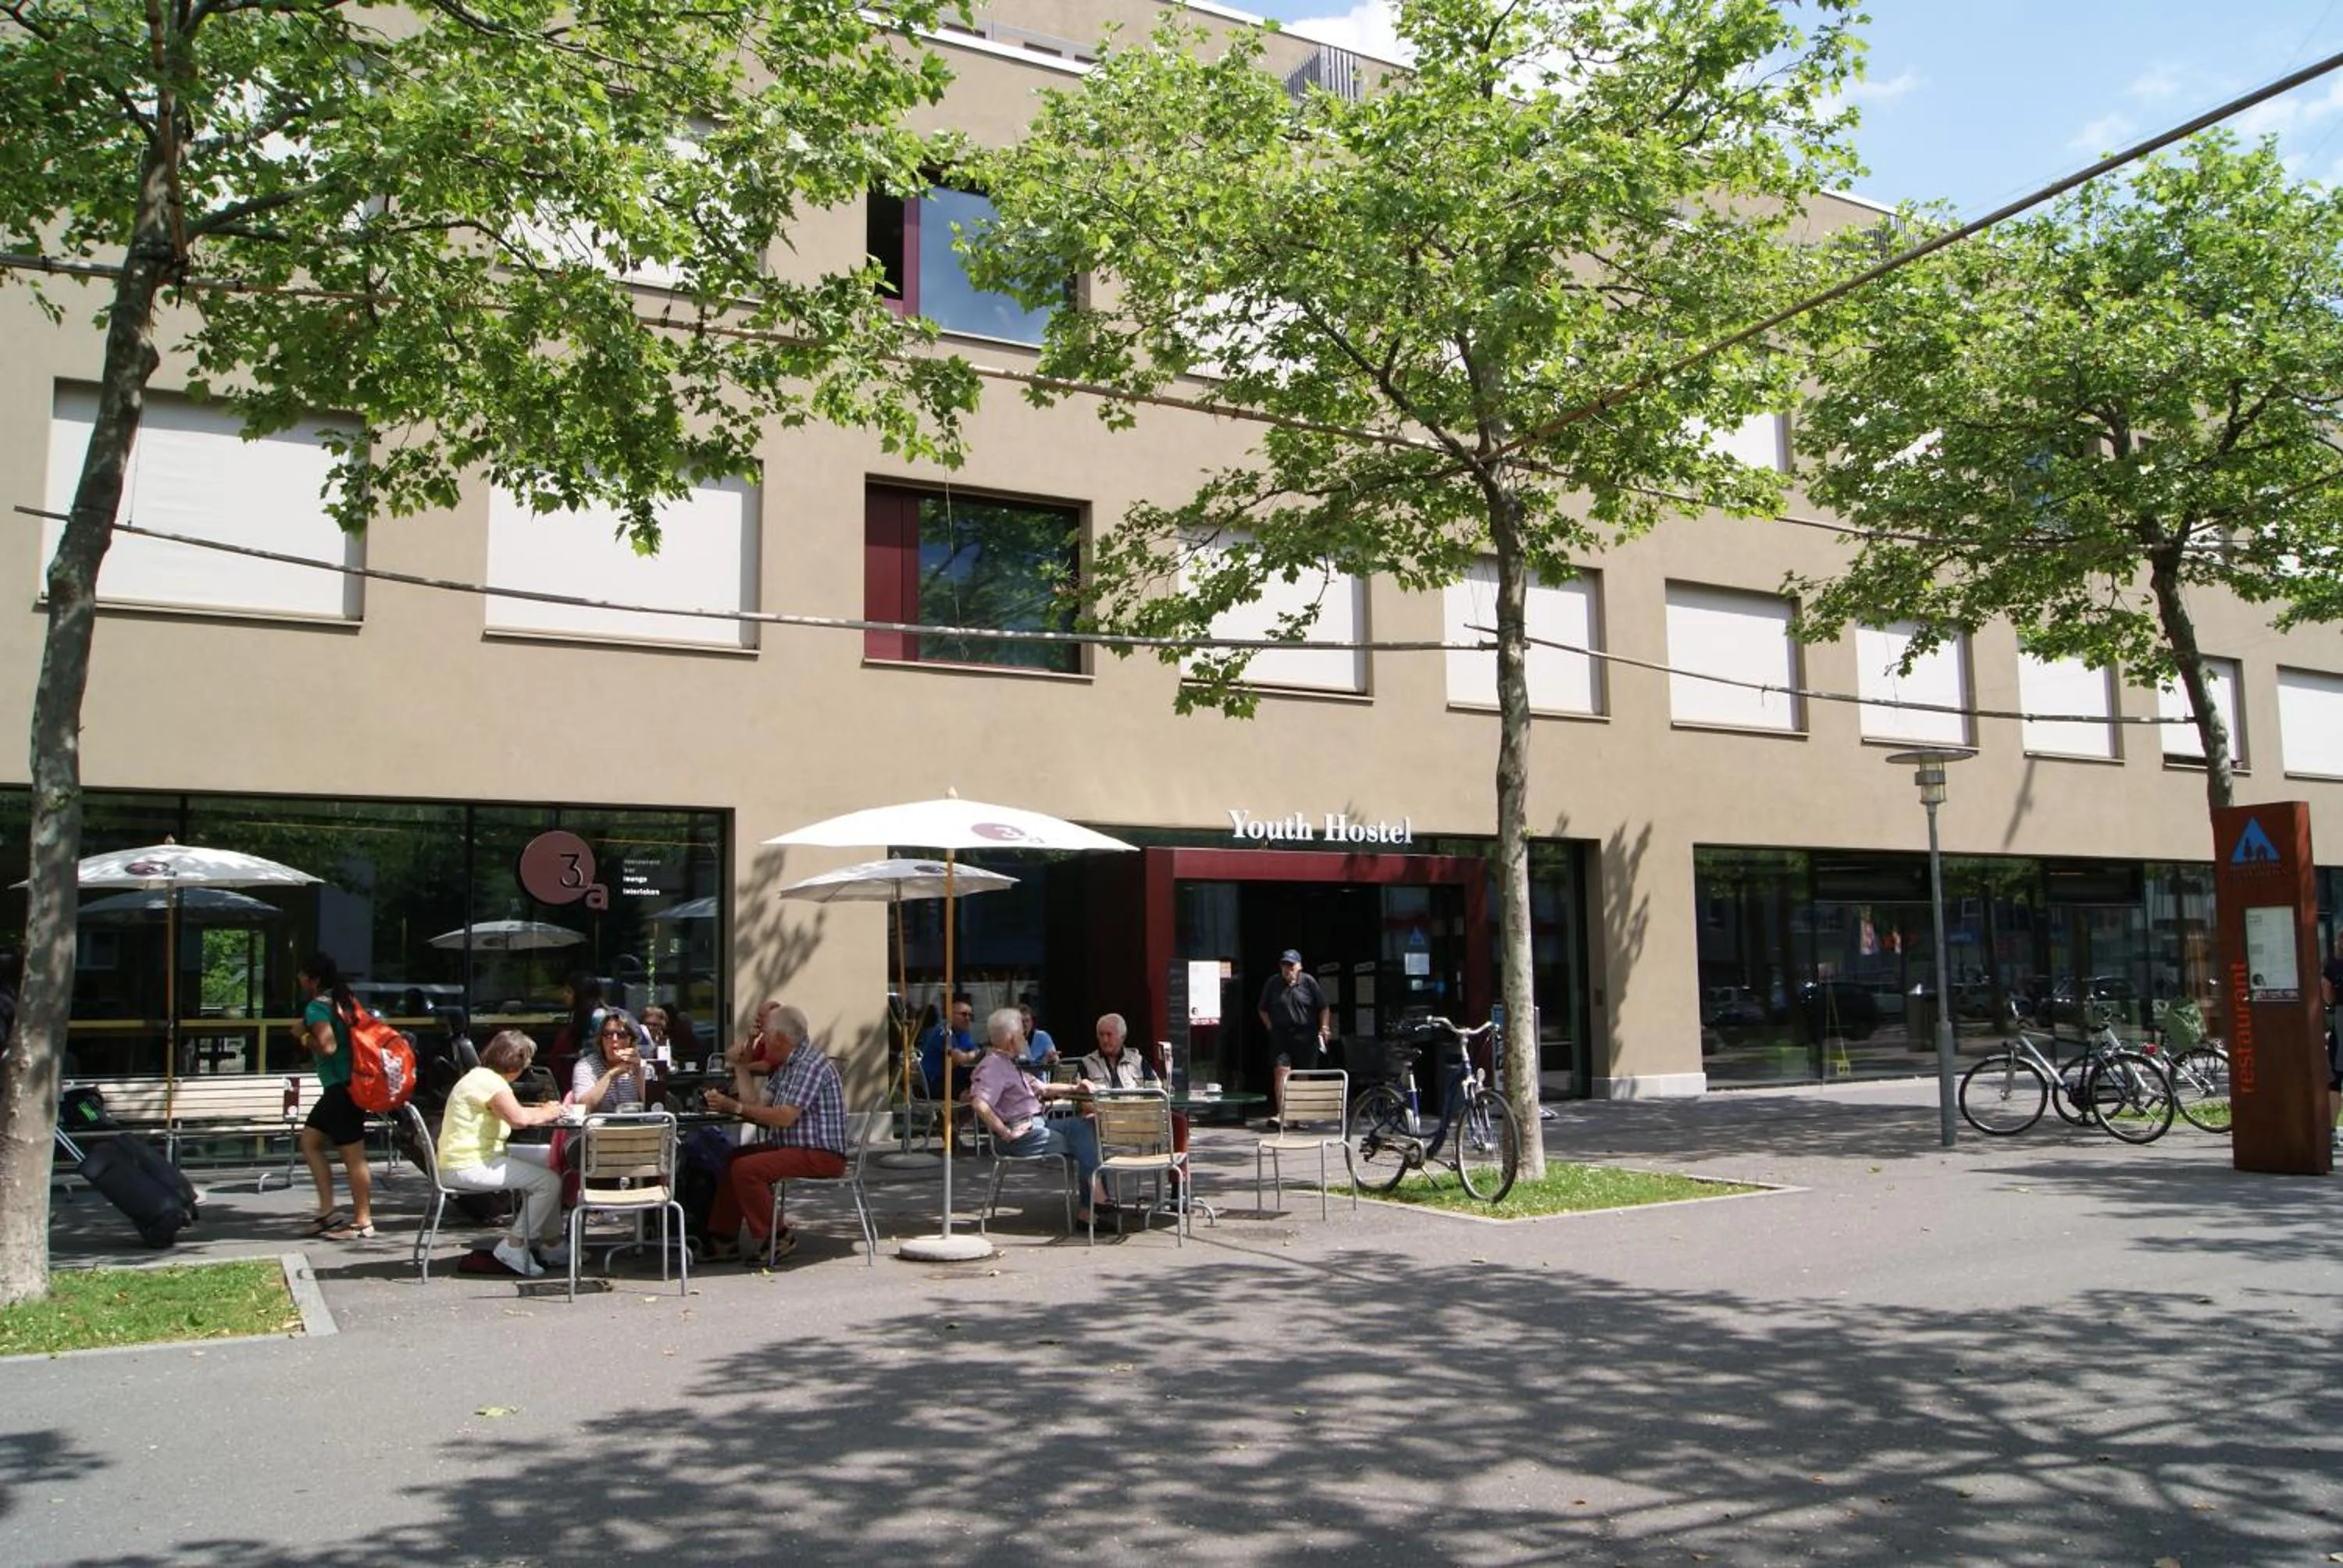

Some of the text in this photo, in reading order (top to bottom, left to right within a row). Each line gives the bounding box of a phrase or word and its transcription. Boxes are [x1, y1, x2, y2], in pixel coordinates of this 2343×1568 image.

[1228, 809, 1413, 844] Youth Hostel
[2231, 961, 2256, 1093] restaurant
